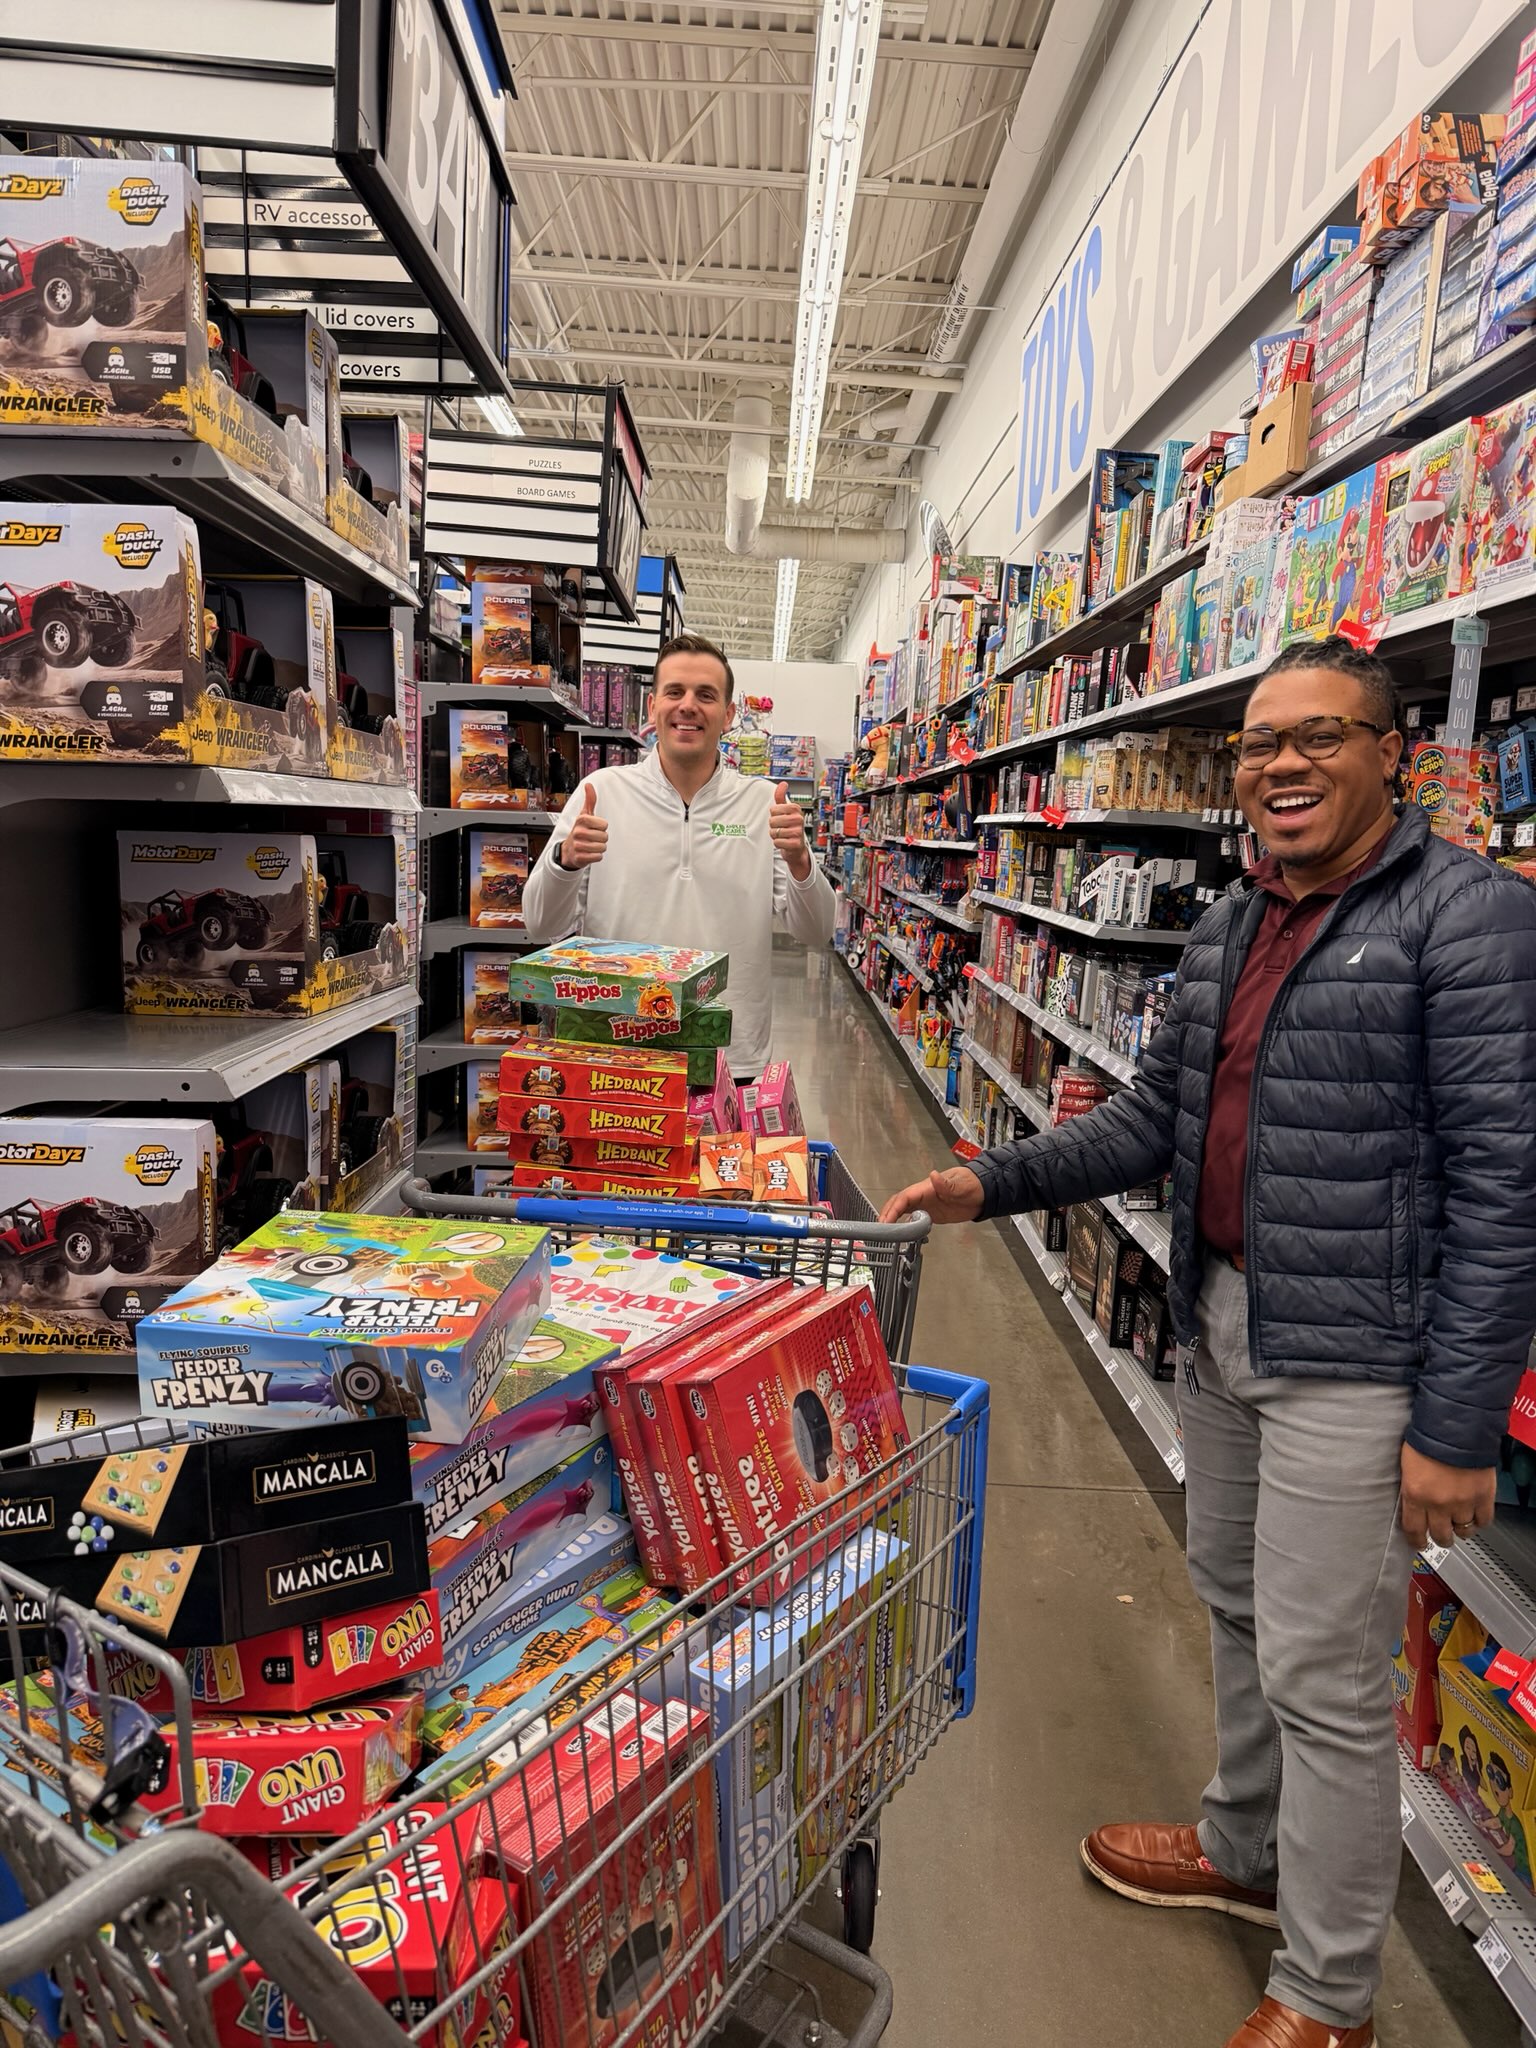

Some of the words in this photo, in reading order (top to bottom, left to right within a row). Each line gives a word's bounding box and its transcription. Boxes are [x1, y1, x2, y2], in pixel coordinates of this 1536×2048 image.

[120, 185, 160, 198] DASH
[126, 195, 167, 208] DUCK
[253, 203, 282, 223] RV
[1014, 224, 1104, 536] TOYS
[1104, 154, 1146, 436] &
[1156, 0, 1484, 376] GAM
[325, 306, 347, 325] lid
[354, 313, 415, 328] covers
[153, 366, 171, 374] USB
[340, 362, 401, 378] covers
[0, 396, 105, 414] WRANGLER
[218, 410, 274, 464] WRANGLER
[528, 458, 562, 470] PUZZLES
[516, 486, 545, 498] BOARD
[547, 488, 576, 499] GAMES
[1307, 483, 1347, 533] LIFE
[116, 530, 154, 542] DASH
[122, 540, 162, 554] DUCK
[120, 554, 149, 562] INCLUDED
[485, 597, 526, 605] POLARIS
[479, 667, 533, 680] RZR
[150, 704, 168, 712] USB
[192, 724, 213, 744] Jeep
[216, 728, 269, 752] WRANGLER
[462, 723, 503, 731] POLARIS
[0, 734, 103, 750] WRANGLER
[457, 792, 510, 805] RZR
[134, 846, 215, 860] MotorDayz
[482, 845, 523, 853] POLARIS
[261, 859, 290, 867] DUCK
[1172, 861, 1182, 885] Taboo
[312, 987, 326, 1000] Jeep
[328, 973, 367, 995] WRANGLER
[136, 998, 160, 1007] Jeep
[167, 999, 246, 1009] WRANGLER
[589, 1070, 669, 1098] HEDBANZ
[589, 1108, 668, 1137] HEDBANZ
[137, 1151, 173, 1162] DASH
[142, 1159, 181, 1170] DUCK
[596, 1141, 672, 1168] HEDBANZ
[717, 1155, 739, 1182] Jenga
[767, 1159, 789, 1191] Jenga
[312, 1297, 480, 1317] FRENZY
[344, 1315, 439, 1328] FEEDER
[19, 1333, 123, 1347] WRANGLER
[158, 1350, 194, 1360] FLYING
[197, 1344, 250, 1357] SQUIRRELS
[172, 1358, 242, 1379] FEEDER
[151, 1371, 272, 1409] FRENZY
[746, 1394, 761, 1427] WIN!
[283, 1456, 310, 1466] CARDINAL
[423, 1464, 453, 1493] FLYING
[454, 1429, 496, 1465] SQUIRRELS
[755, 1427, 785, 1494] ULTIMATE
[262, 1457, 368, 1495] MANCALA
[435, 1447, 489, 1500] FEEDER
[423, 1444, 511, 1535] FRENZY
[618, 1457, 660, 1541] Yahtzee
[765, 1480, 782, 1513] ROLL
[654, 1471, 697, 1556] Yahtzee
[704, 1472, 750, 1558] Yahtzee
[276, 1549, 385, 1595] MANCALA
[452, 1549, 499, 1605] FEEDER
[440, 1542, 519, 1648] FRENZY
[380, 1598, 434, 1657] UNO
[472, 1598, 544, 1657] SCAVENGER
[544, 1581, 579, 1606] HUNT
[513, 1610, 541, 1634] GAME
[398, 1627, 436, 1670] GIANT
[1493, 1660, 1520, 1679] Rollback
[258, 1745, 346, 1807] UNO
[280, 1783, 347, 1826] GIANT
